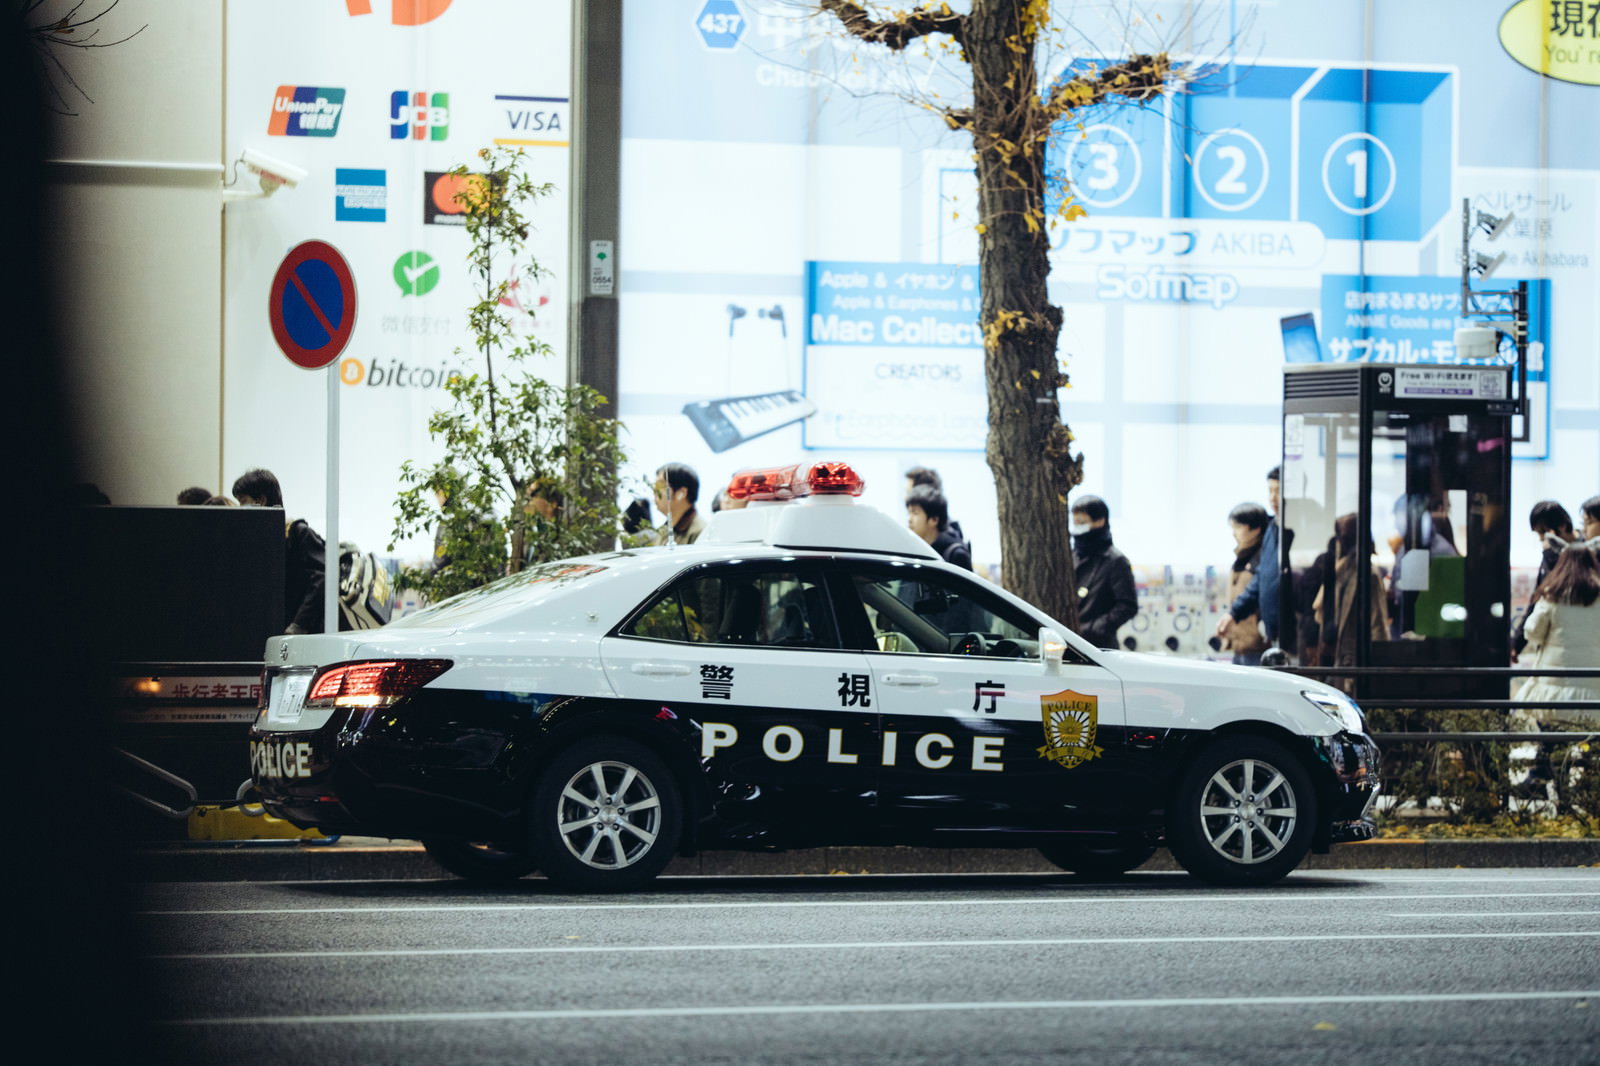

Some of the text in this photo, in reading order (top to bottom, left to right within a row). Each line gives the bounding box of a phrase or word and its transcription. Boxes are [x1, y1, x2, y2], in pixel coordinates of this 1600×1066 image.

[700, 13, 739, 33] 437
[1544, 44, 1600, 64] You'r
[275, 97, 342, 116] UnionPay
[506, 111, 561, 131] VISA
[1212, 232, 1295, 256] AKIBA
[820, 271, 868, 288] Apple
[874, 272, 887, 288] &
[961, 275, 974, 291] &
[1096, 263, 1239, 309] Sofmap
[812, 314, 875, 343] Mac
[874, 362, 961, 382] CREATORS
[1047, 700, 1092, 712] POLICE
[701, 722, 1006, 772] POLICE
[250, 741, 312, 778] POLICE
